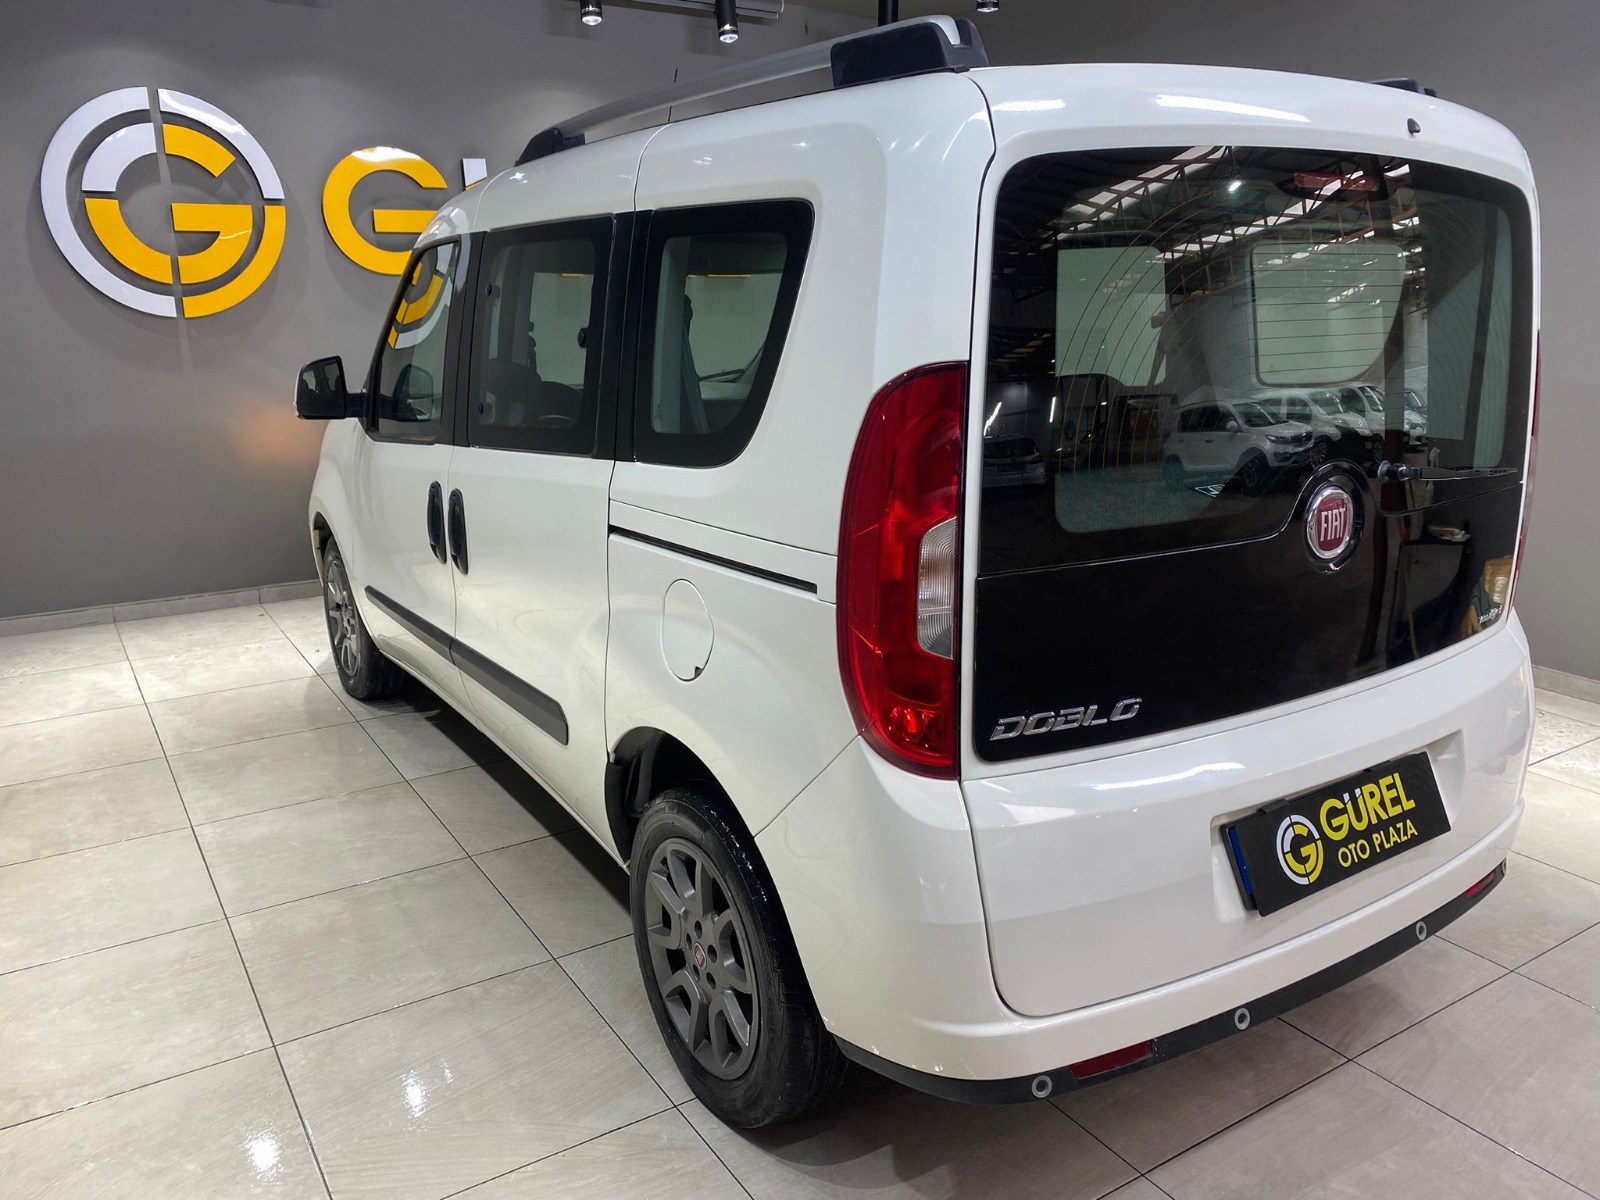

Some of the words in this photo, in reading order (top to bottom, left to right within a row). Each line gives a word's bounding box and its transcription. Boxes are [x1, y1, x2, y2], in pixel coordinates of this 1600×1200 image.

[1319, 505, 1347, 542] FIAT
[1319, 772, 1416, 841] GÜREL
[1337, 839, 1371, 869] OTO
[1373, 818, 1419, 853] PLAZA
